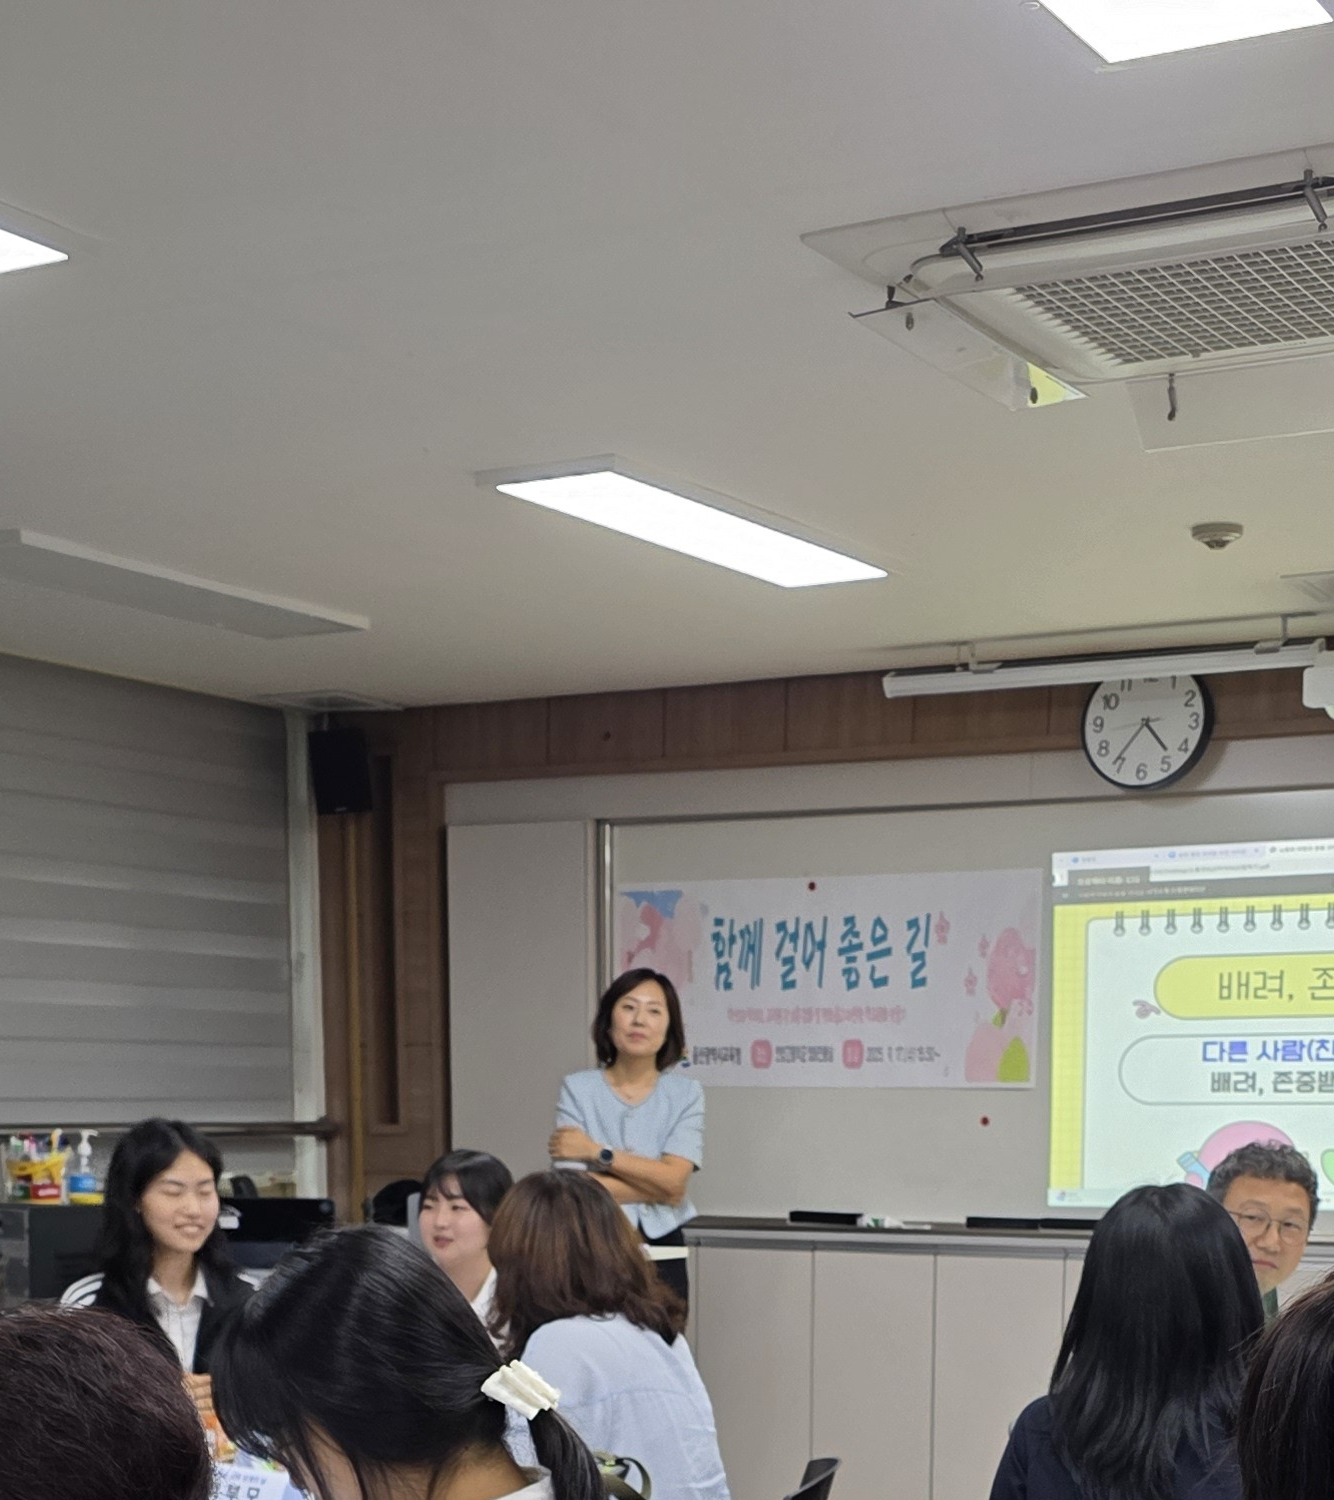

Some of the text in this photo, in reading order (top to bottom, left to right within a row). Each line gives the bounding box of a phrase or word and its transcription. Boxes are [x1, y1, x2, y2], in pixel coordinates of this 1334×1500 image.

[1102, 693, 1119, 710] 10
[1184, 690, 1196, 707] 2
[1092, 716, 1104, 733] 9
[1188, 712, 1199, 730] 3
[1097, 740, 1110, 757] 8
[1178, 738, 1189, 753] 4
[1113, 756, 1126, 773] 7
[1135, 763, 1147, 780] 6
[1160, 756, 1171, 772] 5
[711, 912, 933, 991] 함께 걸어 좋은 길
[1219, 970, 1295, 1000] 배려,
[1201, 1040, 1248, 1062] 다른
[1211, 1071, 1263, 1095] 배려,
